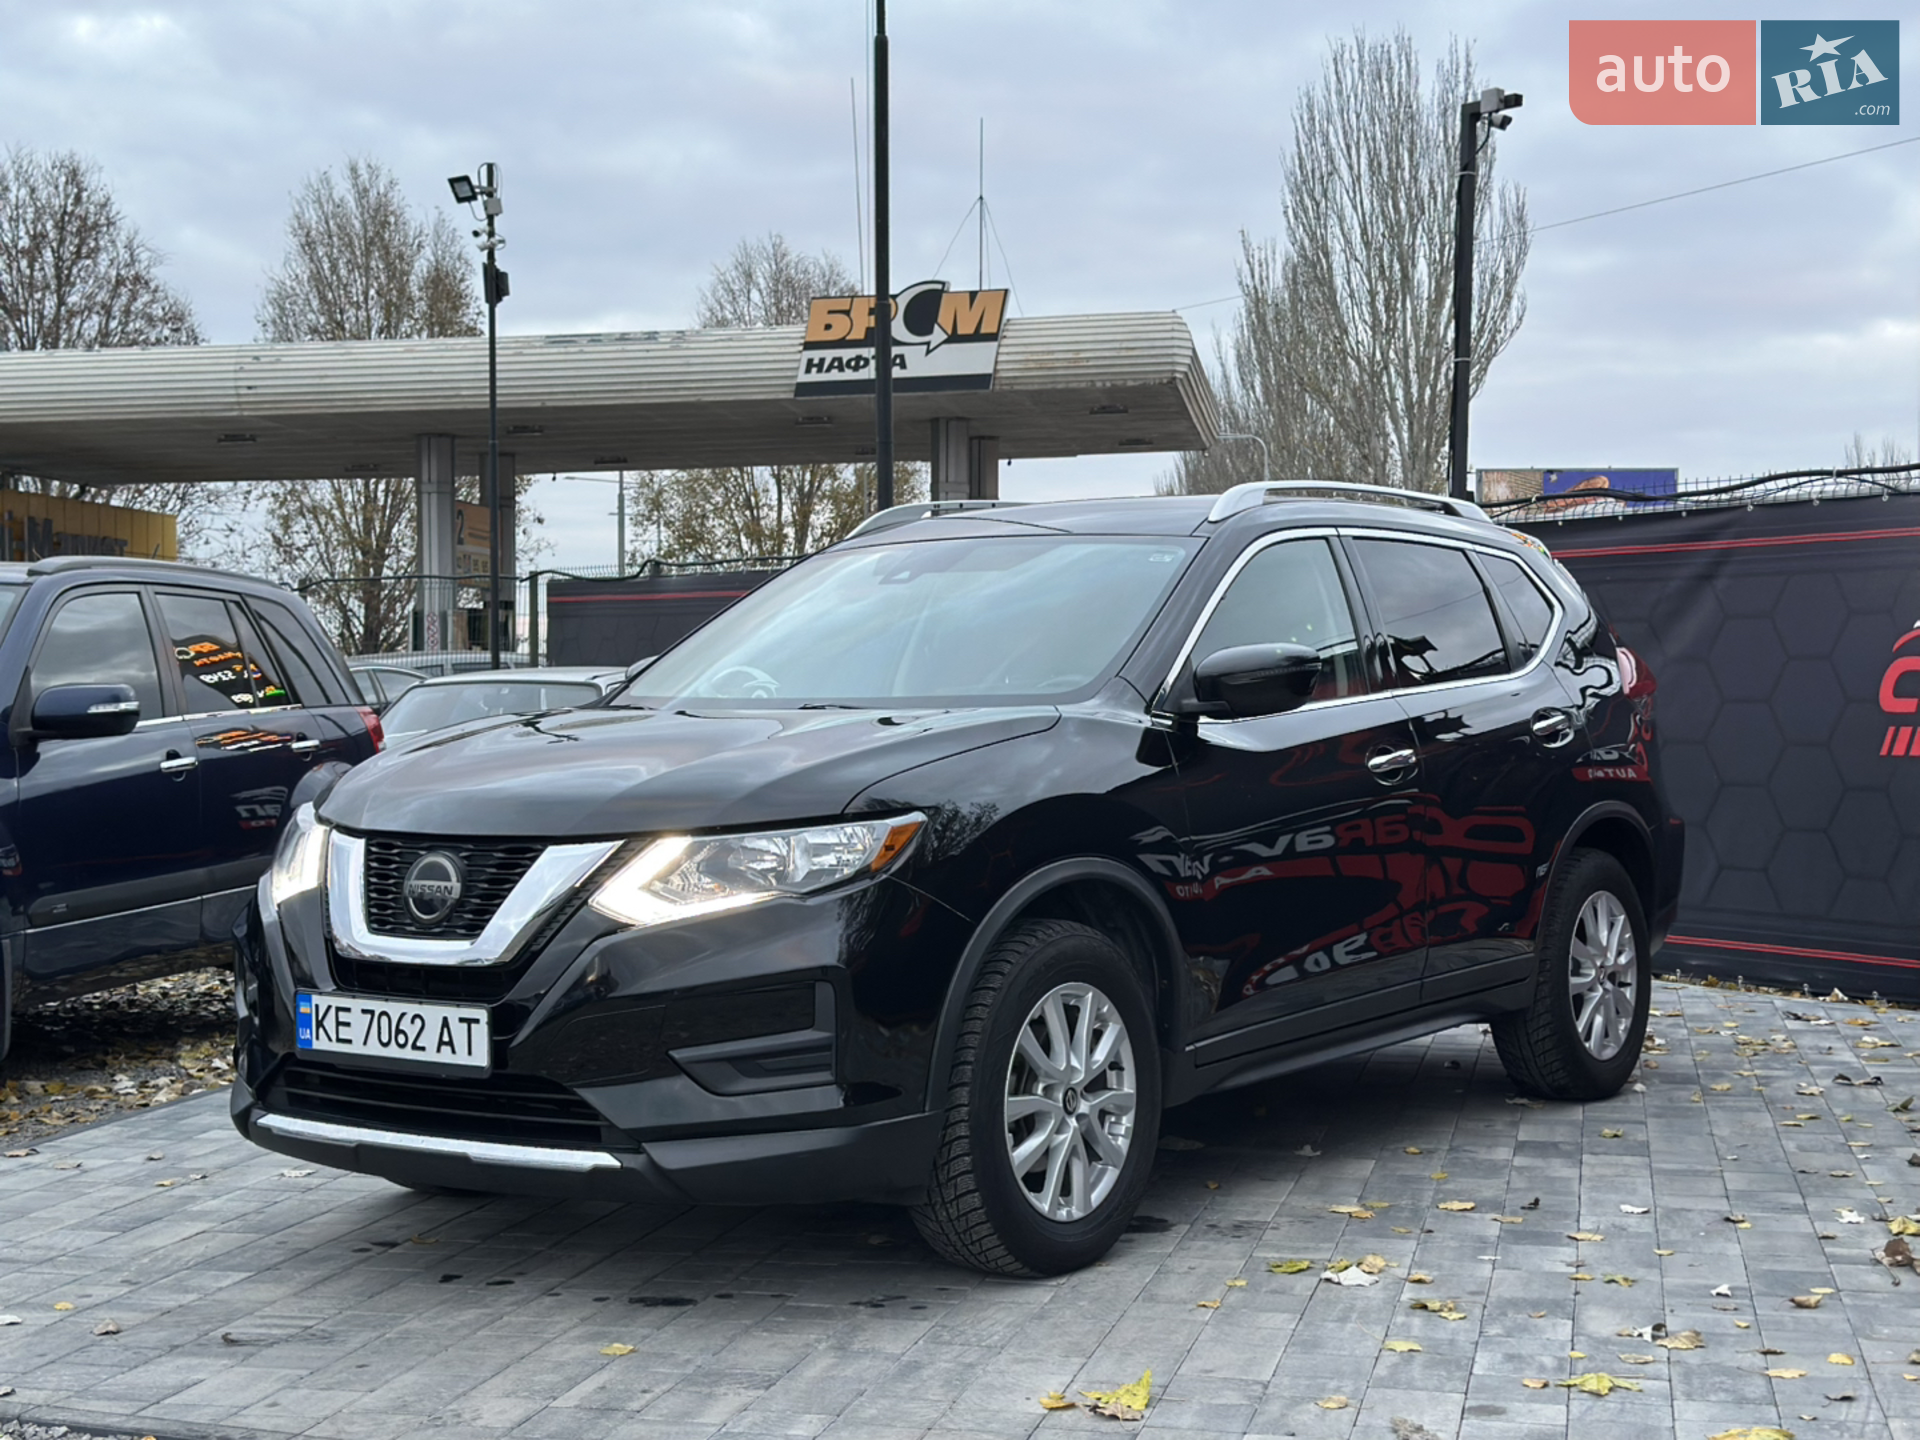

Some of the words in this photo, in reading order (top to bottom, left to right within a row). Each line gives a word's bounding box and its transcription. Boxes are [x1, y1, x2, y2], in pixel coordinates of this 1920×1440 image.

[804, 353, 908, 375] НАФА
[408, 883, 454, 896] NISSAN
[299, 1027, 311, 1040] UA
[314, 1003, 353, 1044] KE
[360, 1008, 427, 1052] 7062
[435, 1015, 481, 1057] AT
